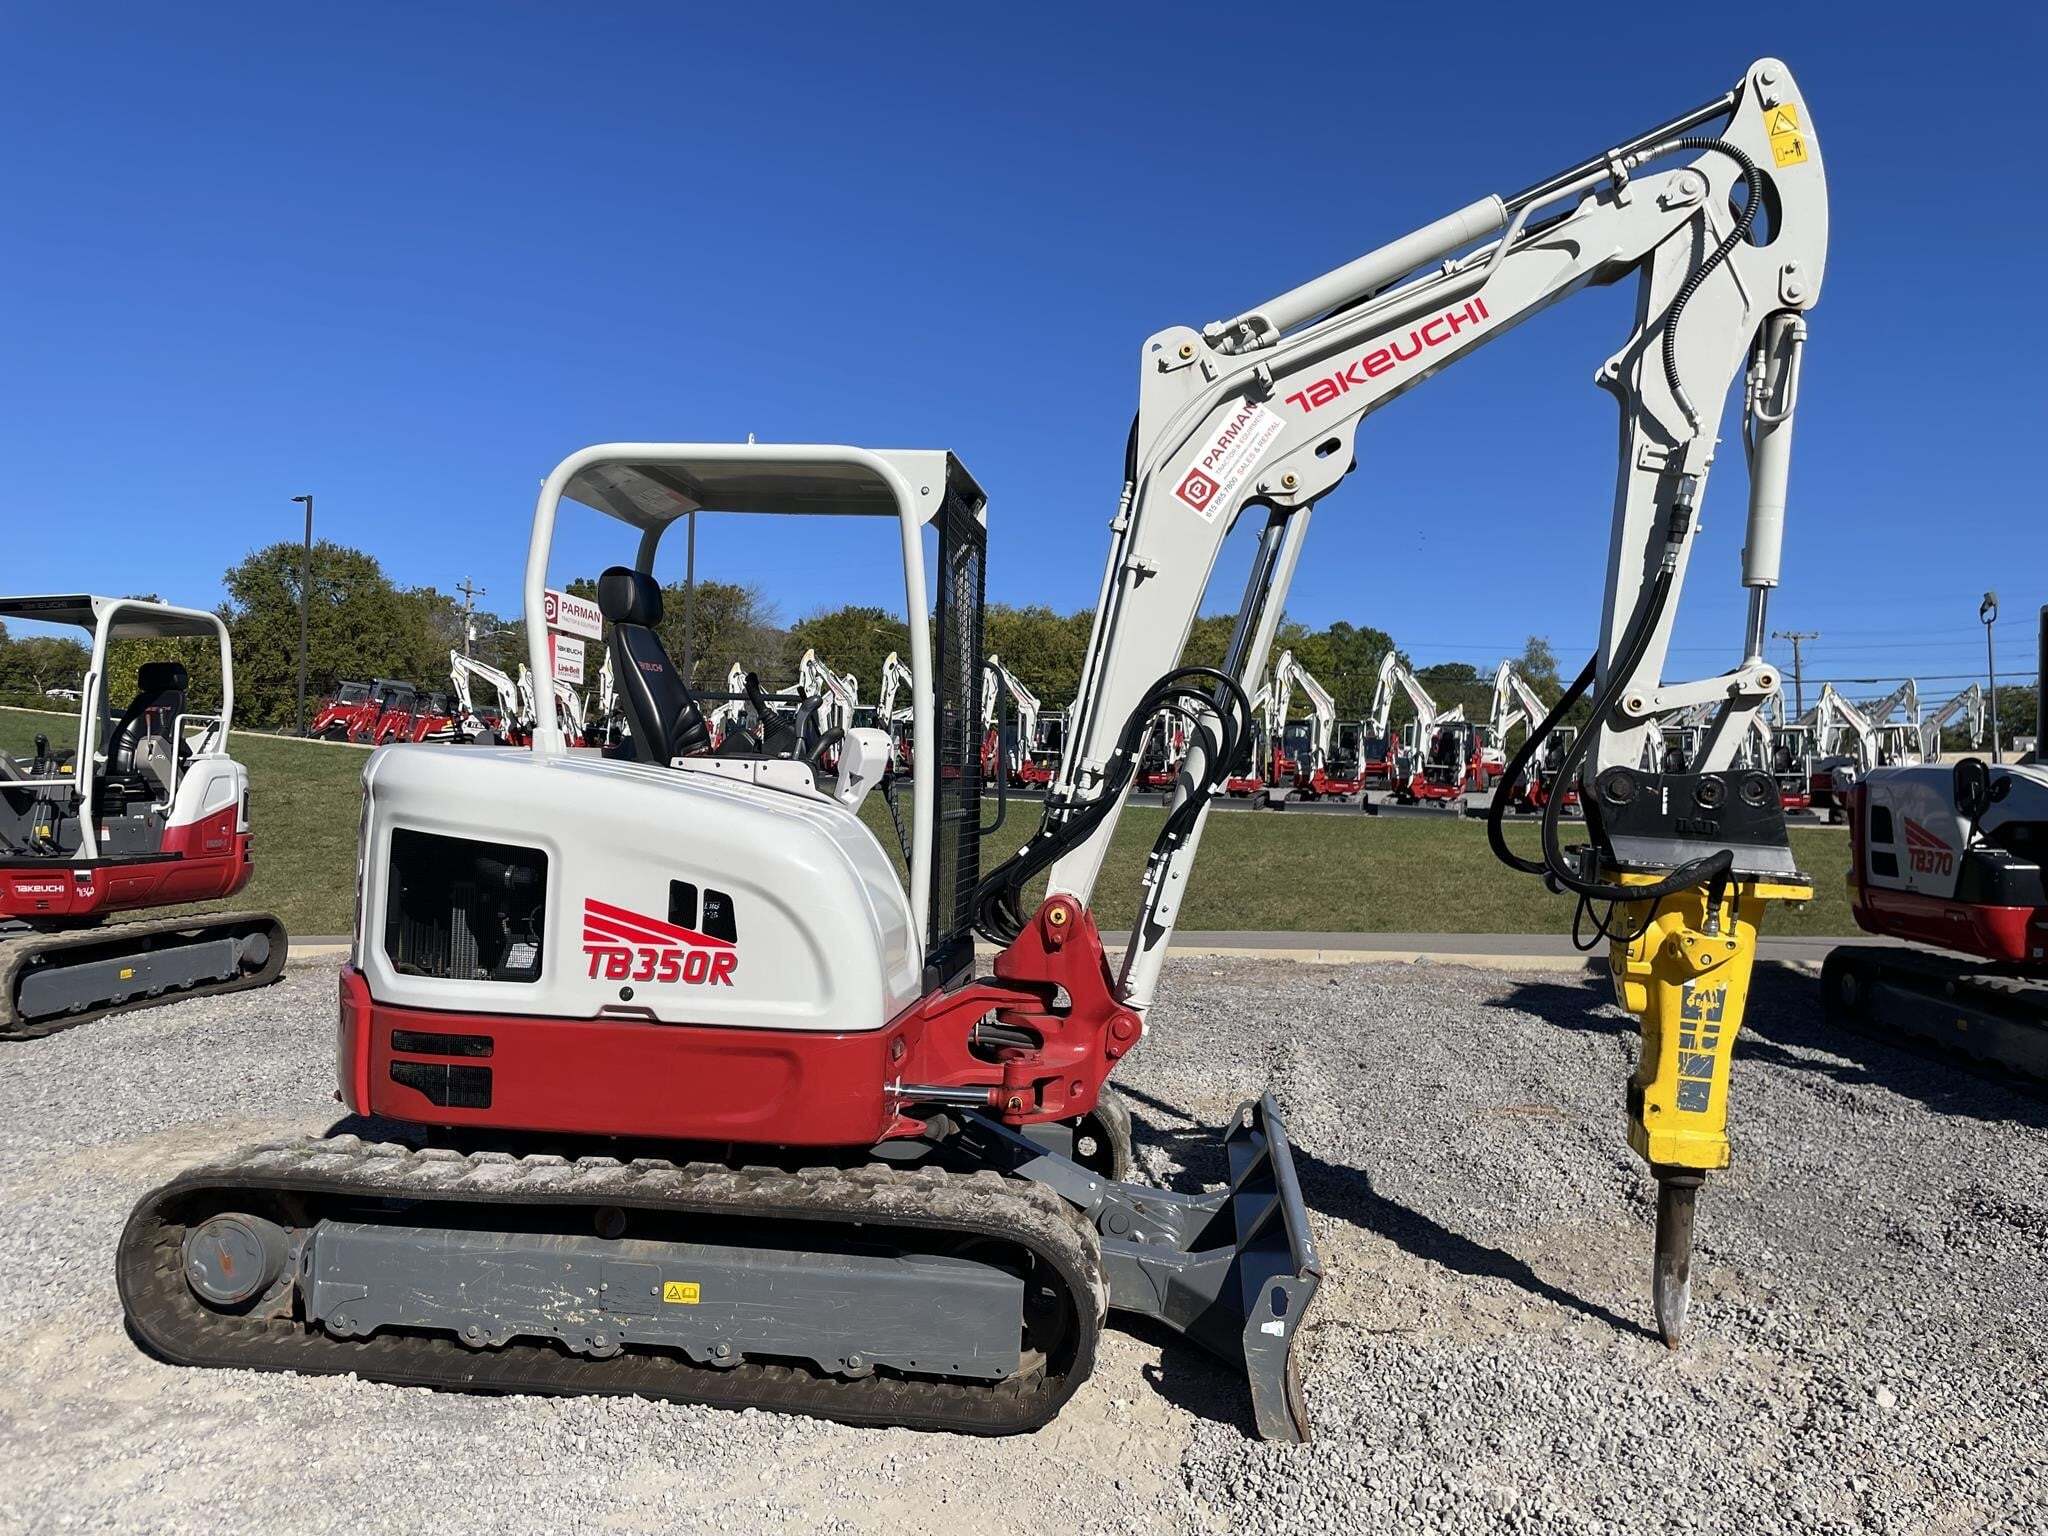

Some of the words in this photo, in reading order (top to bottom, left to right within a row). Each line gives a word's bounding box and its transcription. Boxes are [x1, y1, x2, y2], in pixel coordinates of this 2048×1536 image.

[1202, 401, 1258, 470] PARMAN
[1238, 454, 1256, 475] SALES
[1257, 421, 1280, 448] RENTAL
[561, 601, 601, 623] PARMAN
[1908, 847, 1954, 877] TB370
[583, 945, 738, 986] TB350R
